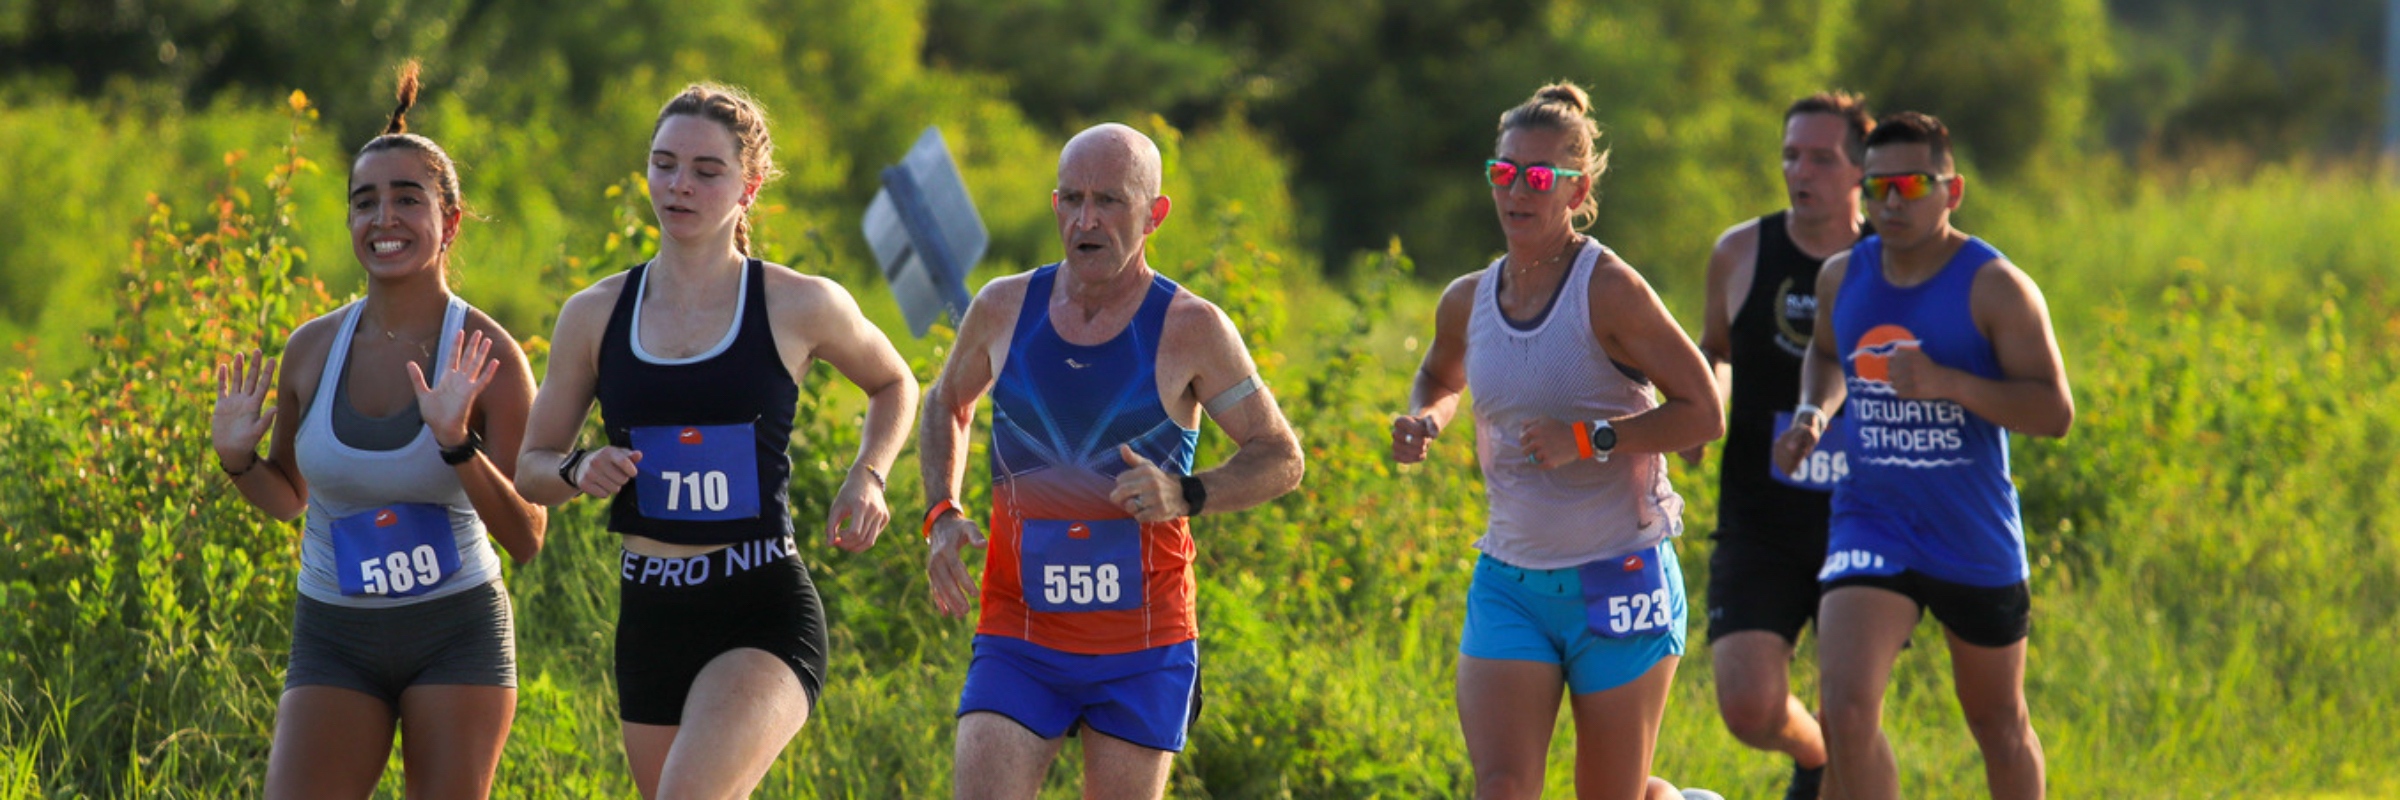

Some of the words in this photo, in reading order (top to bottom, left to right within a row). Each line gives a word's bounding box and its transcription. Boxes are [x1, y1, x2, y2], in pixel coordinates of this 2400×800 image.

[661, 470, 730, 511] 710
[360, 544, 441, 595] 589
[640, 554, 710, 587] PRO
[1044, 563, 1120, 604] 558
[1608, 588, 1671, 633] 523
